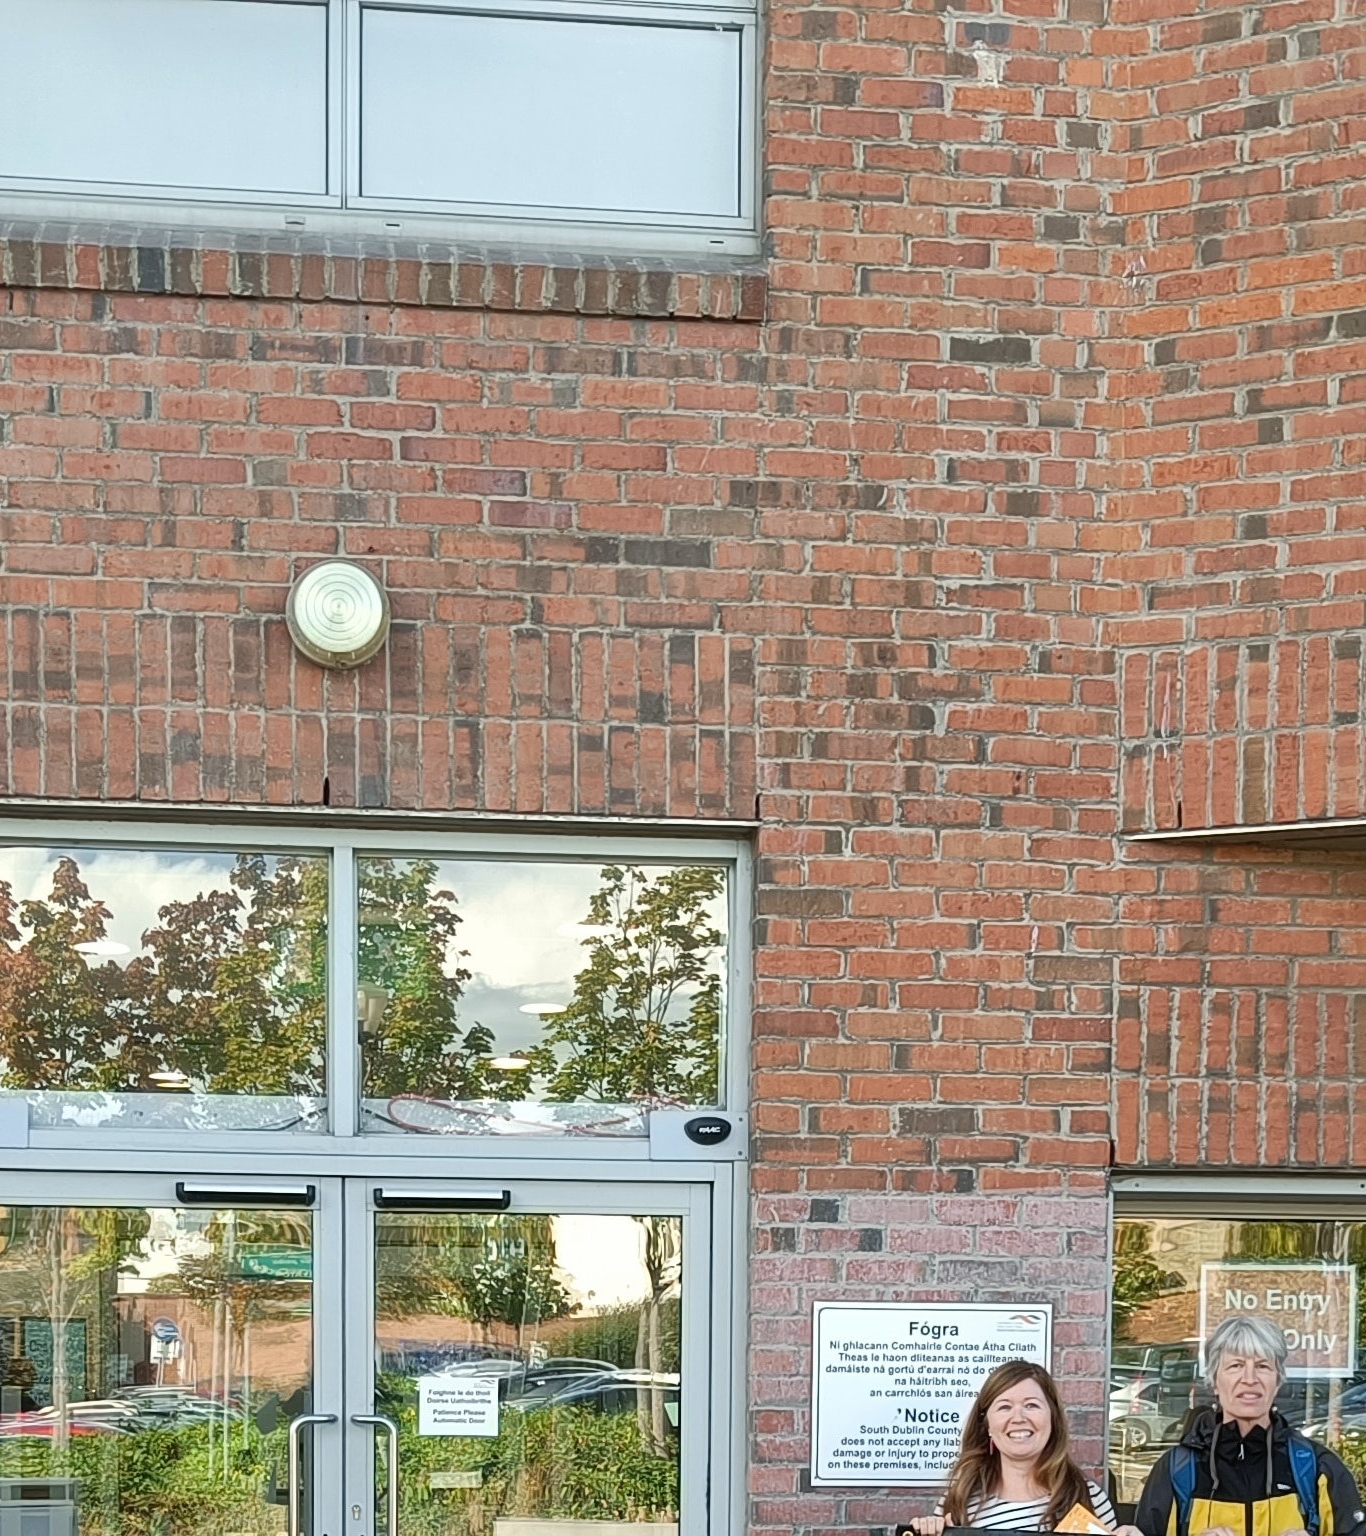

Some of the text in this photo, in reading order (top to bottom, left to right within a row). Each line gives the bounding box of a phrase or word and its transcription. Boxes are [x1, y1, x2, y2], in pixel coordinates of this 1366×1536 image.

[1225, 1289, 1331, 1316] No Entry
[909, 1321, 959, 1339] Fógra
[842, 1340, 888, 1351] ghlacann
[891, 1341, 942, 1351] Comhairle
[944, 1342, 979, 1351] Contae
[982, 1341, 1006, 1352] Átha
[1008, 1342, 1037, 1352] Cliath
[1284, 1328, 1337, 1355] Only
[838, 1352, 969, 1363] Theas le haon dliteanas as
[825, 1364, 870, 1374] damáiste
[972, 1365, 986, 1375] do
[894, 1378, 907, 1386] na
[910, 1376, 948, 1386] háitribh
[870, 1388, 952, 1398] an carrchlós san
[860, 1425, 962, 1437] South Dublin County
[841, 1437, 865, 1446] does
[868, 1438, 884, 1446] not
[887, 1438, 920, 1448] accept
[923, 1439, 940, 1448] any
[833, 1449, 929, 1460] damage or injury to
[843, 1461, 870, 1470] these
[873, 1461, 921, 1471] premises,
